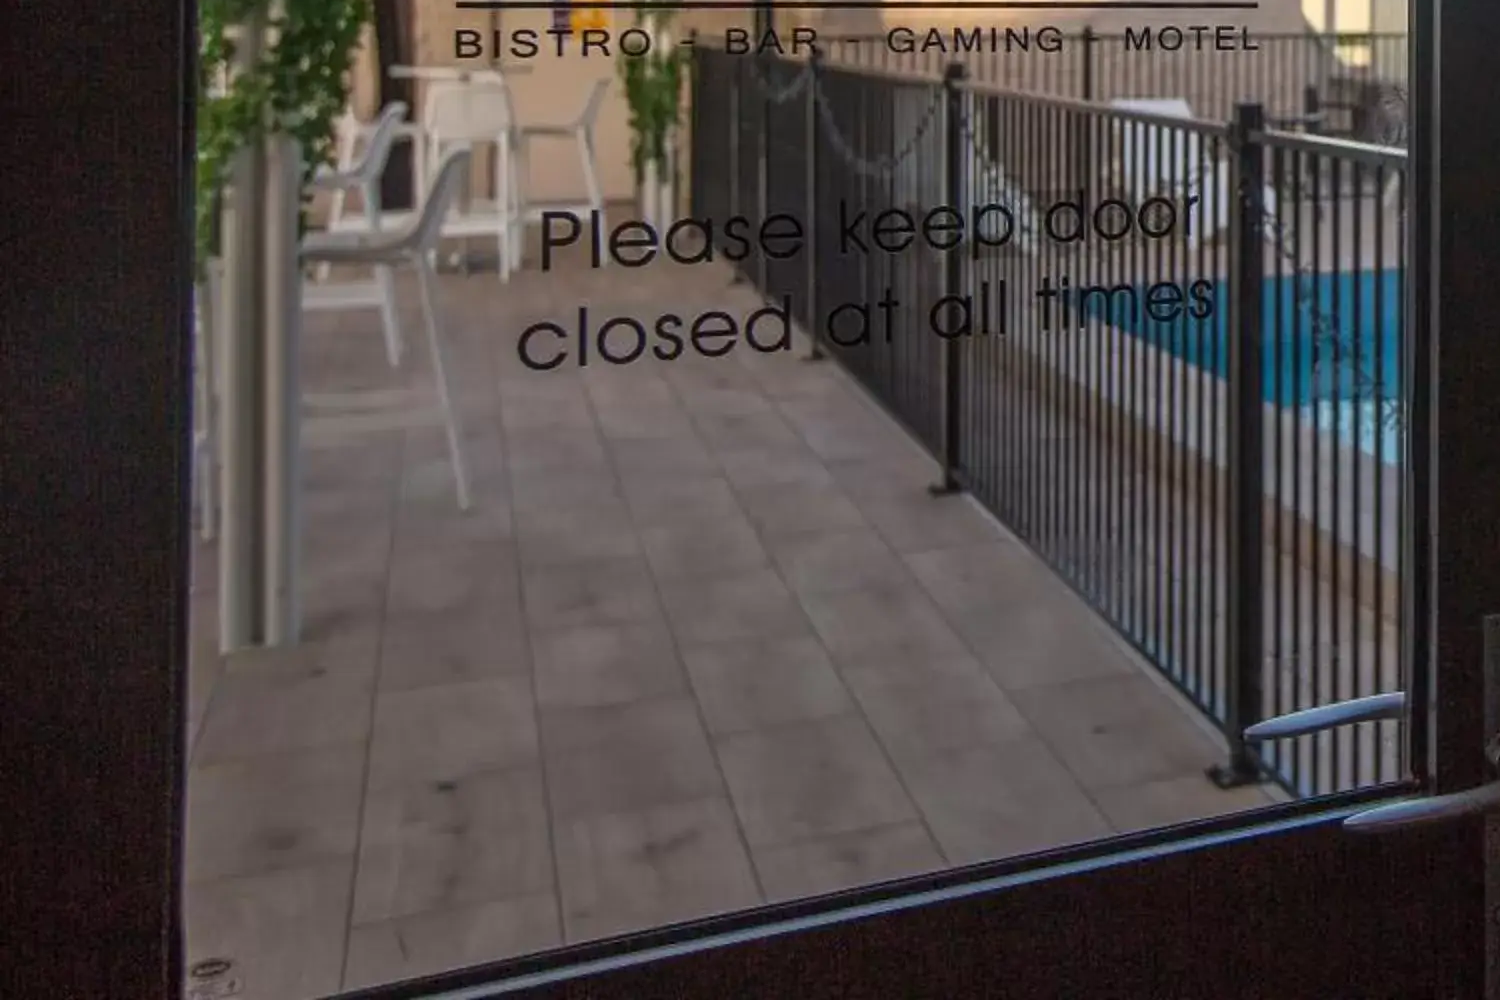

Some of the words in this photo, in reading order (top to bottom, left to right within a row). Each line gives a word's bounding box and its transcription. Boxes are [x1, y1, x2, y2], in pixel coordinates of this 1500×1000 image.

[455, 28, 651, 59] BISTRO
[725, 27, 818, 56] BAR
[888, 26, 1062, 54] GAMING
[1126, 25, 1259, 52] MOTEL
[541, 209, 803, 272] Please
[840, 198, 1013, 261] keep
[1045, 187, 1199, 242] door
[517, 295, 792, 371] closed
[827, 287, 899, 347] at
[930, 280, 1006, 340] all
[1035, 275, 1214, 330] times
